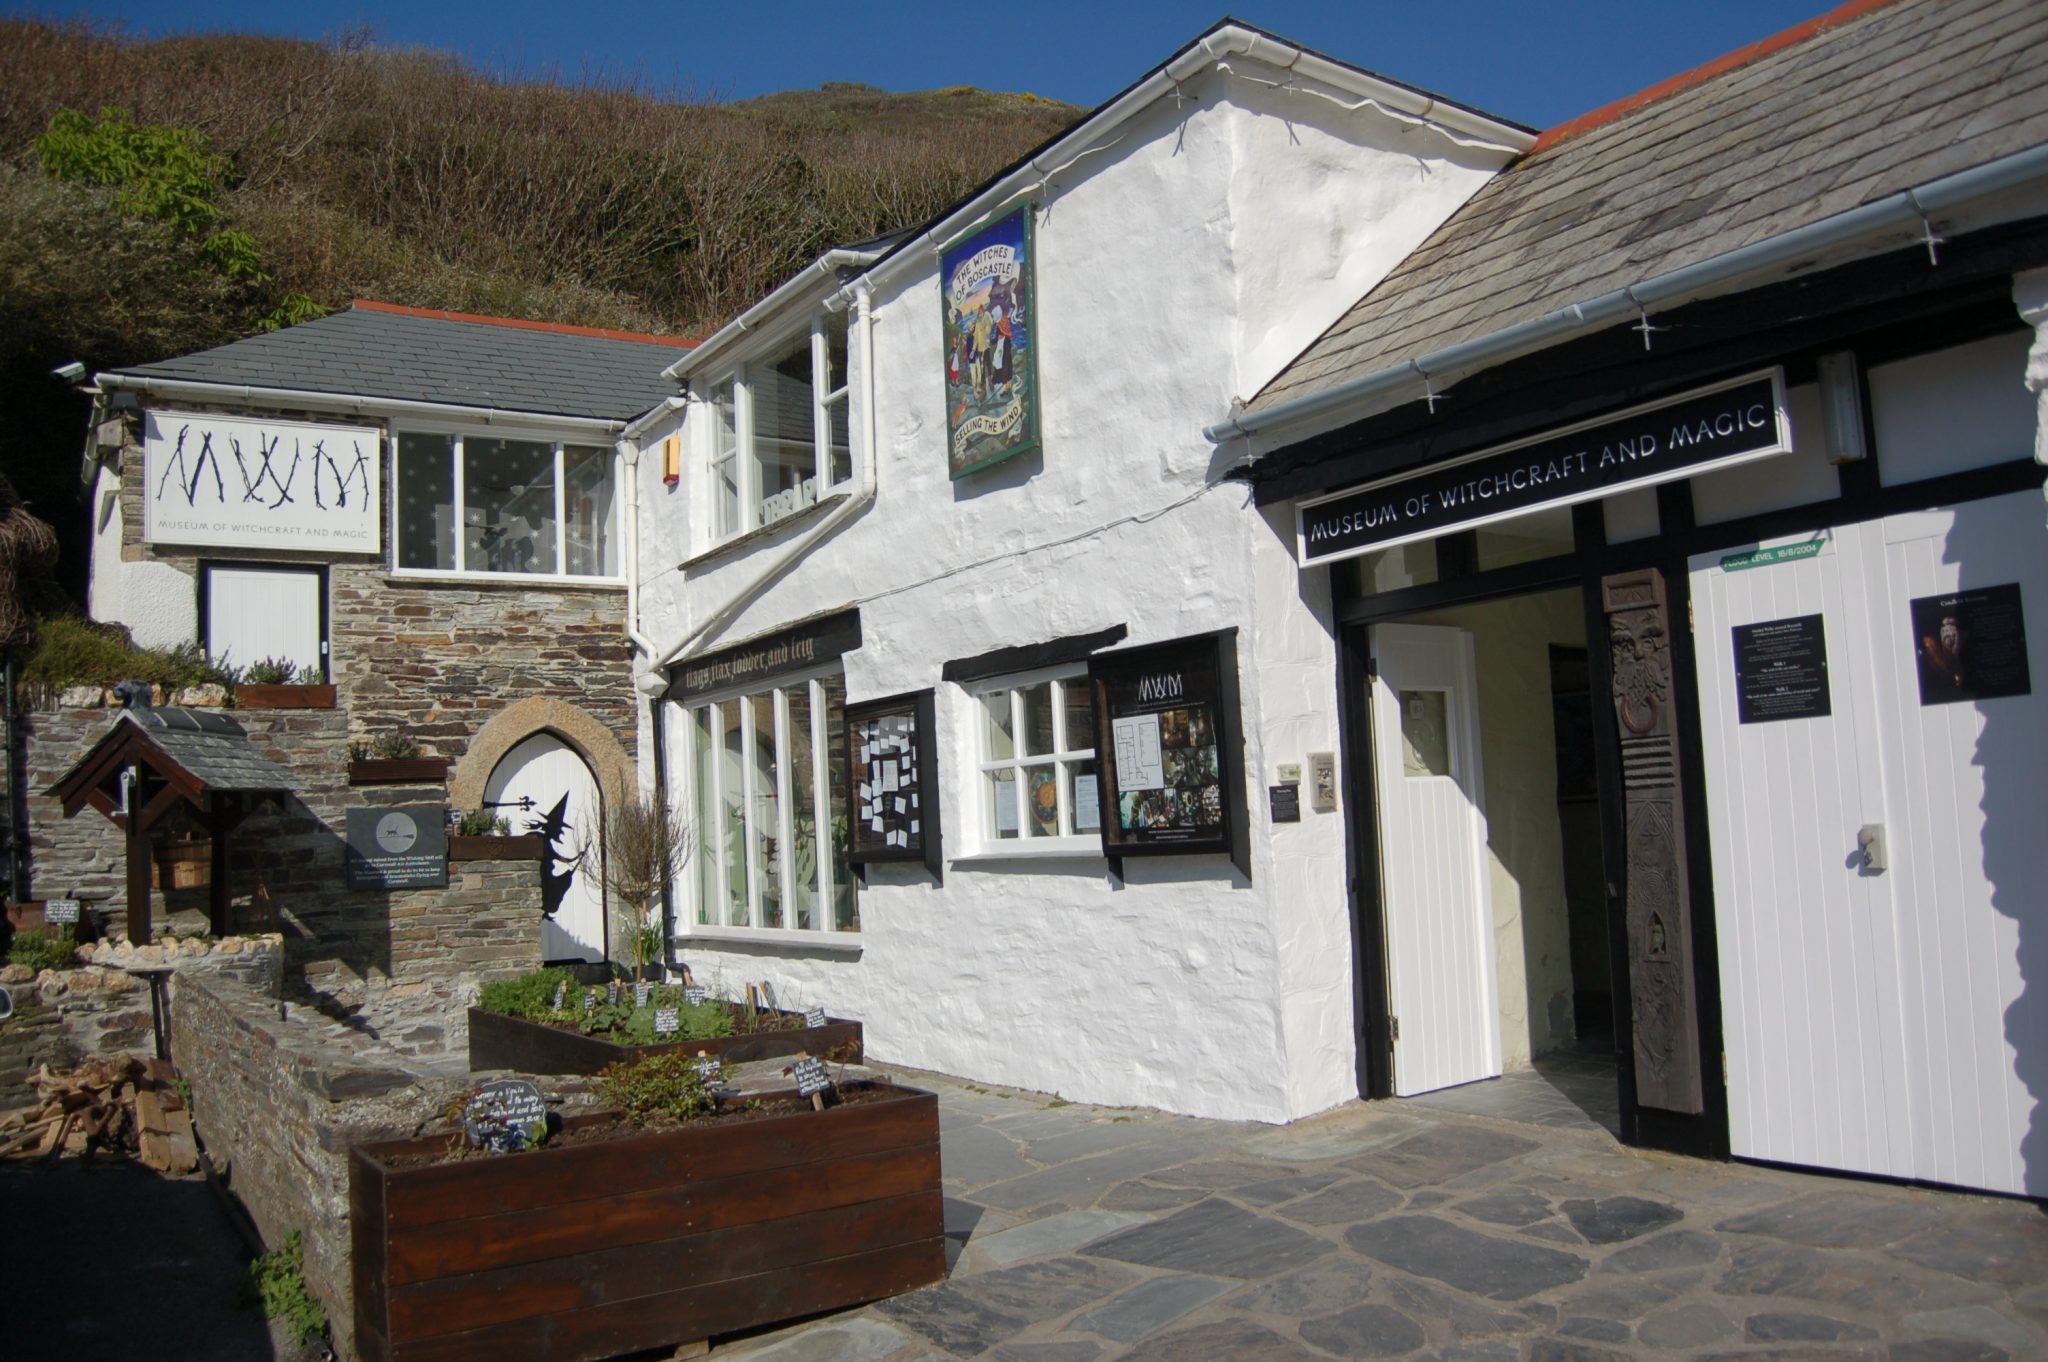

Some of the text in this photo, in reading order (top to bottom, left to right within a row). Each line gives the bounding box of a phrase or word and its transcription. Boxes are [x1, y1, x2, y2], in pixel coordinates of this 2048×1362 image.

[956, 262, 1012, 300] OF BOSCASTLE
[957, 246, 1008, 284] THE WITCHES
[955, 406, 1018, 445] SELLING THE WIND
[1311, 404, 1766, 543] MUSEUM OF WITCHCRAFT AND MAGIC
[157, 519, 369, 539] MUSEUM OF WITCHCRAFT AND MAGIC
[1751, 552, 1774, 563] LEVEL
[768, 641, 788, 663] and
